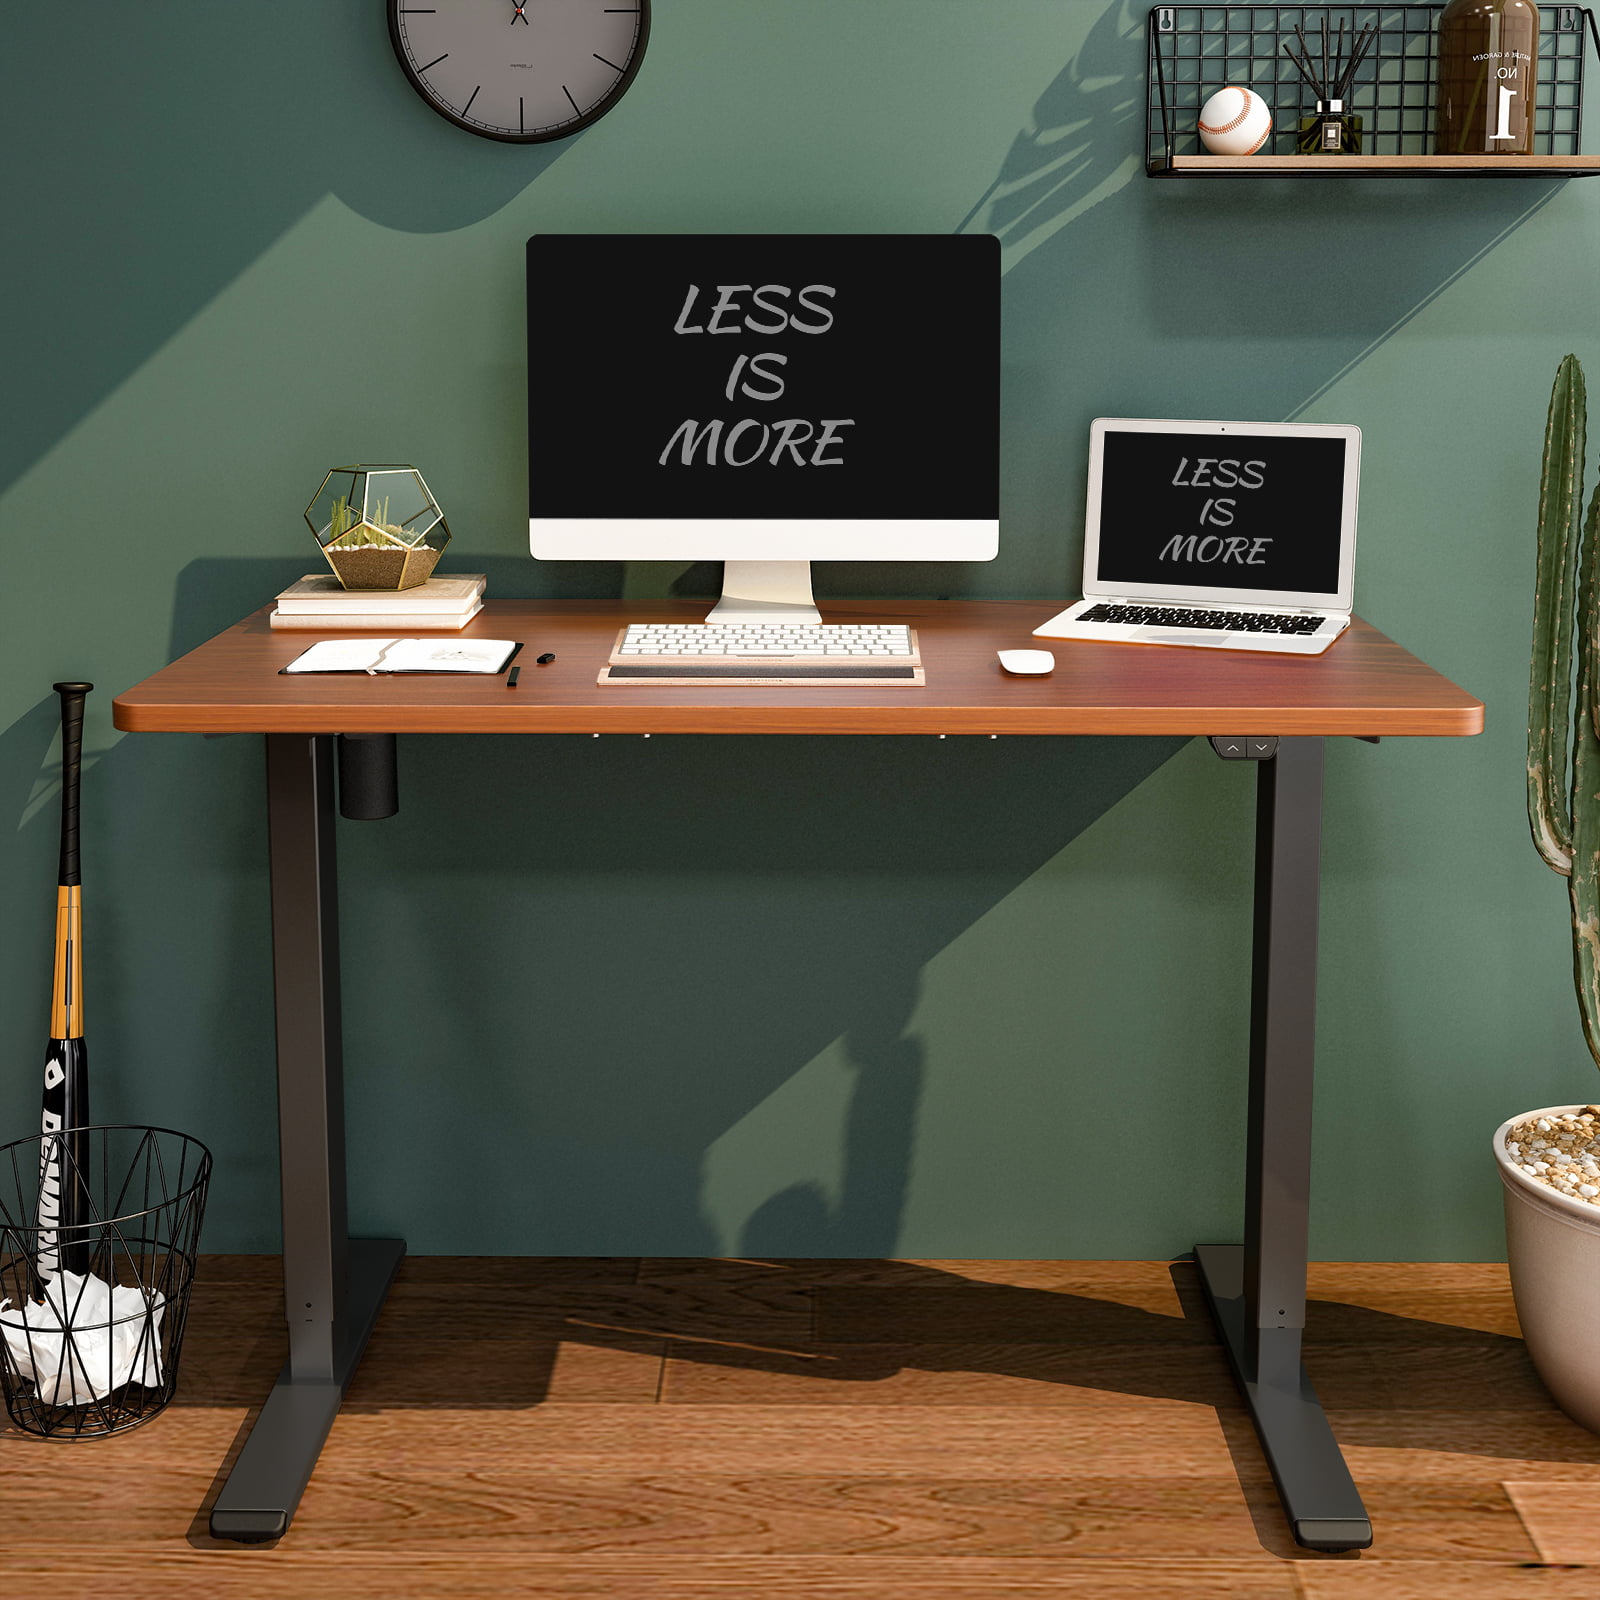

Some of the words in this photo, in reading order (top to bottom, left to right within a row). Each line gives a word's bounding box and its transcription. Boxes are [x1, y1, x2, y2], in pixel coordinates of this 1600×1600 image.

[674, 285, 836, 334] LESS
[726, 353, 787, 401] IS
[659, 419, 855, 466] MORE
[1172, 457, 1266, 489] LESS
[1200, 499, 1236, 526] IS
[1159, 535, 1273, 564] MORE
